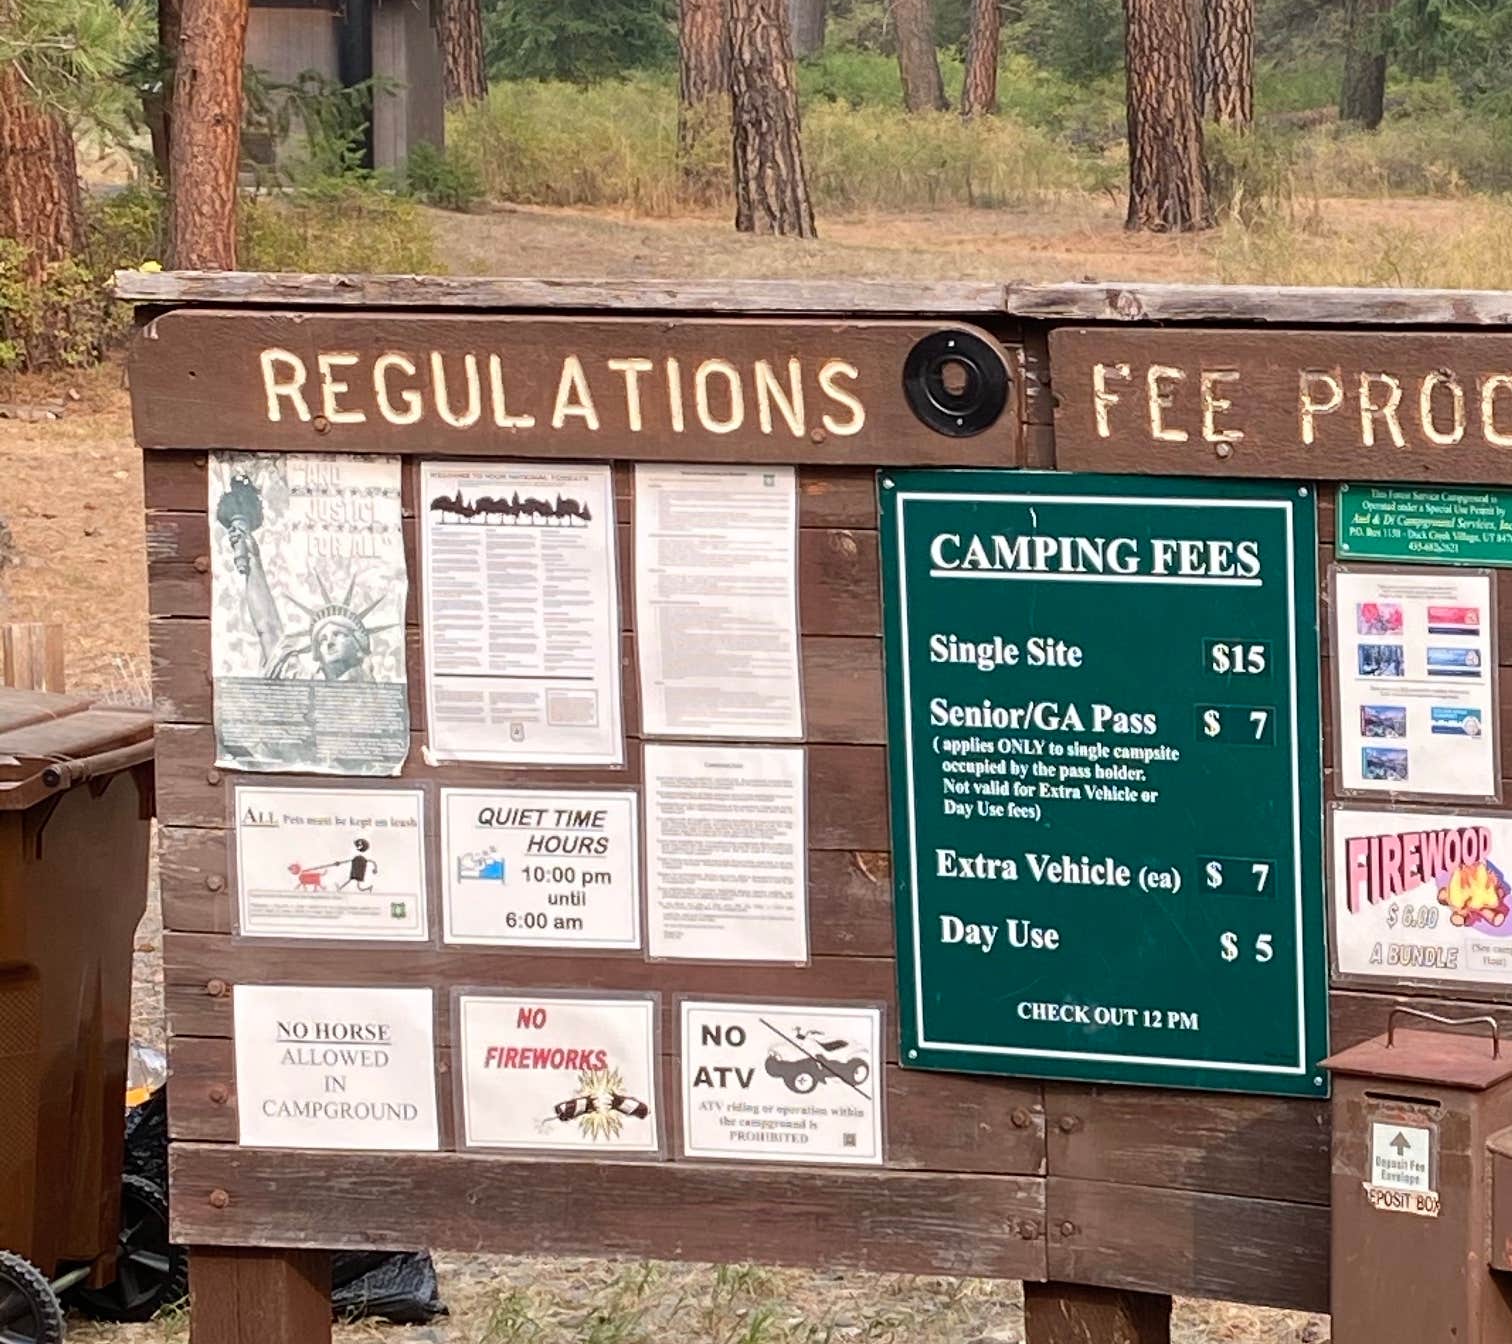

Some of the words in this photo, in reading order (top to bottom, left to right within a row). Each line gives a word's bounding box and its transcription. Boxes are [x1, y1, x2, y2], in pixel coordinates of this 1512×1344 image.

[260, 348, 866, 438] REGULATIONS
[1092, 363, 1244, 443] FEE
[930, 533, 1141, 575] CAMPING
[1150, 539, 1261, 577] FEES
[930, 633, 1020, 671] Single
[1026, 637, 1083, 667] Site
[1211, 643, 1266, 674] $15
[930, 698, 1086, 732] Senior/GA
[1091, 703, 1157, 735] Pass
[1249, 711, 1268, 741] 7
[942, 738, 994, 756] applies
[997, 738, 1045, 755] ONLY
[1048, 741, 1064, 756] to
[1067, 741, 1110, 761] single
[1112, 744, 1180, 764] campsite
[942, 759, 1006, 778] occupied
[1010, 761, 1029, 780] by
[1032, 761, 1056, 777] the
[1059, 766, 1091, 784] pass
[1095, 764, 1146, 782] holder.
[943, 778, 970, 795] Not
[974, 779, 1009, 796] valid
[1013, 781, 1036, 798] for
[1039, 783, 1081, 800] Extra
[1084, 784, 1138, 802] Vehicle
[1141, 790, 1158, 803] or
[283, 815, 304, 825] Pets
[335, 816, 346, 826] be
[349, 817, 372, 828] kept
[390, 817, 418, 828] leash
[478, 807, 549, 827] QUIET
[554, 809, 608, 828] TIME
[943, 799, 972, 819] Day
[977, 801, 1004, 817] Use
[1007, 801, 1041, 822] fees)
[527, 835, 609, 855] HOURS
[521, 866, 575, 883] 10:00
[582, 871, 612, 887] pm
[935, 849, 1018, 880] Extra
[1024, 853, 1131, 887] Vehicle
[1138, 866, 1182, 894] (ea)
[1252, 863, 1270, 893] 7
[1345, 826, 1493, 914] FIREWOOD
[548, 891, 586, 906] until
[505, 912, 548, 929] 6:00
[553, 916, 583, 930] am
[939, 915, 998, 953] Day
[1006, 919, 1060, 950] Use
[1255, 933, 1274, 963] 5
[1369, 942, 1383, 965] A
[1387, 943, 1459, 969] BUNDLE
[516, 1007, 547, 1029] NO
[1017, 1001, 1090, 1024] CHECK
[1095, 1006, 1138, 1027] OUT
[1143, 1009, 1163, 1029] 12
[1168, 1011, 1199, 1031] PM
[276, 1020, 309, 1039] NO
[315, 1022, 392, 1041] HORSE
[701, 1024, 747, 1047] NO
[280, 1048, 390, 1068] ALLOWED
[484, 1046, 609, 1072] FIREWORKS
[324, 1075, 347, 1093] IN
[692, 1065, 755, 1089] ATV
[262, 1099, 419, 1121] CAMPGROUND
[700, 1100, 724, 1111] ATV
[727, 1102, 758, 1115] riding
[761, 1105, 774, 1114] or
[777, 1105, 828, 1118] operation
[831, 1106, 865, 1118] within
[719, 1116, 736, 1126] the
[739, 1117, 806, 1130] campground
[808, 1120, 818, 1129] is
[729, 1130, 809, 1144] PROHIBITED
